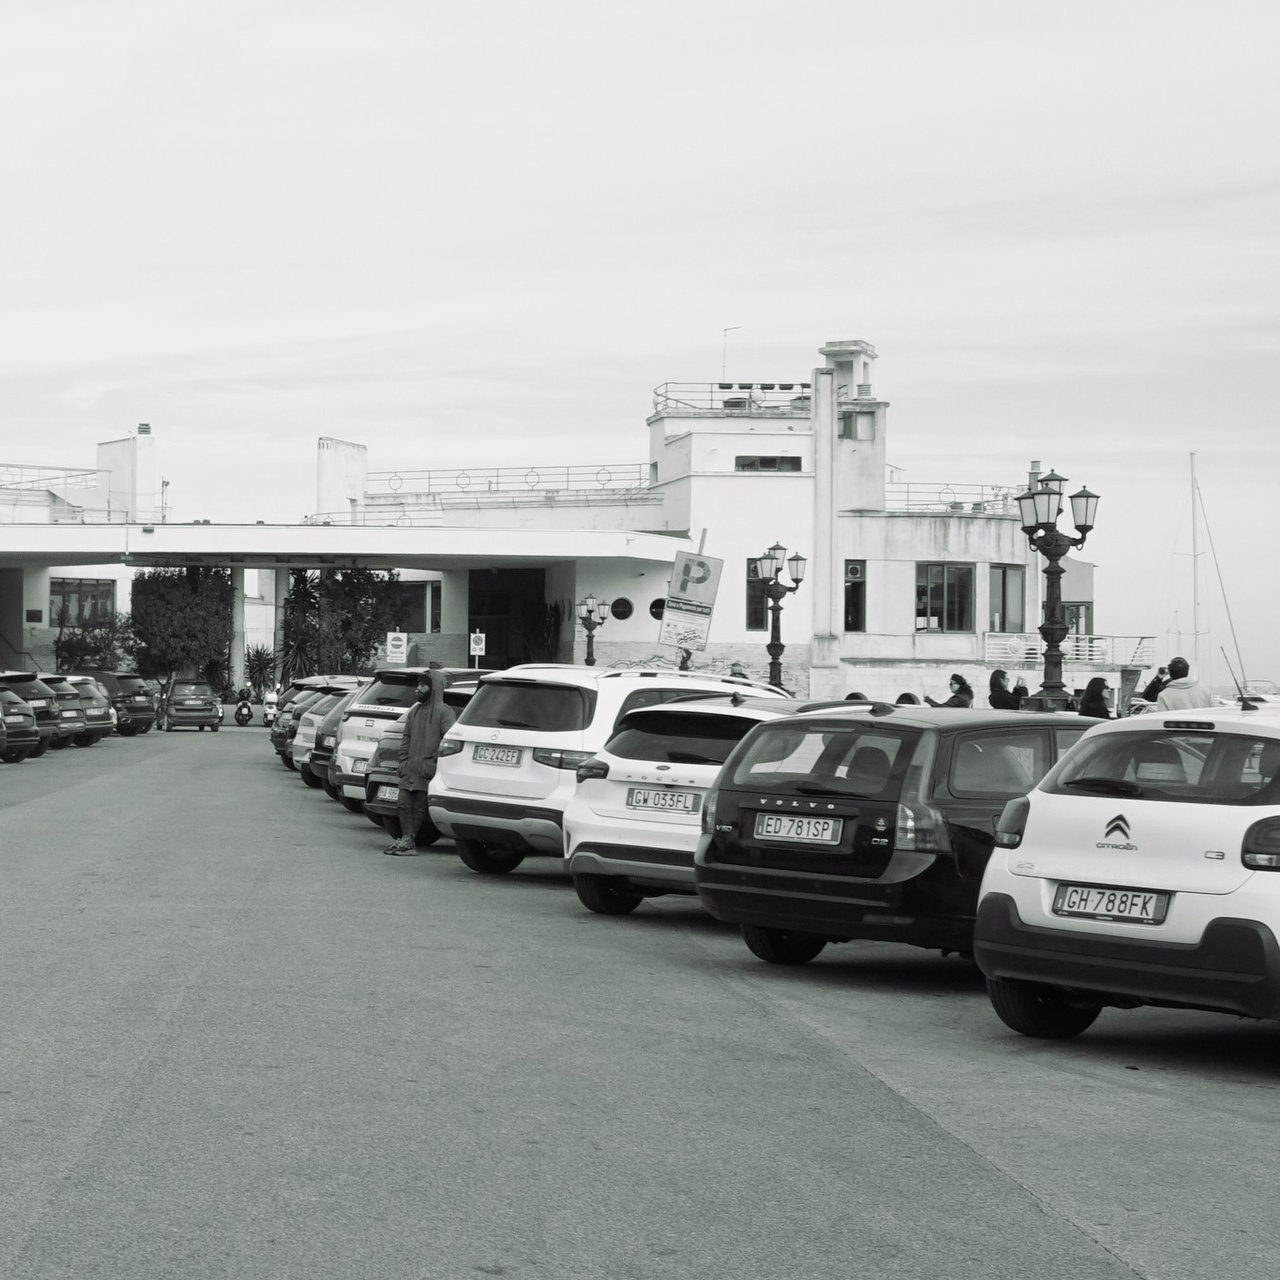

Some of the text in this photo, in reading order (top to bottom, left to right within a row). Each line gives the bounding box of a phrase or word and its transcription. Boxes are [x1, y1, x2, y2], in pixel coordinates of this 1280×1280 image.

[680, 558, 711, 594] P
[478, 747, 517, 762] GC 242EF
[635, 791, 690, 809] GW 033FL
[760, 799, 835, 810] VOLVO
[765, 817, 831, 838] ED 781SP
[1204, 850, 1225, 860] C3
[1067, 890, 1153, 916] GH 788FK
